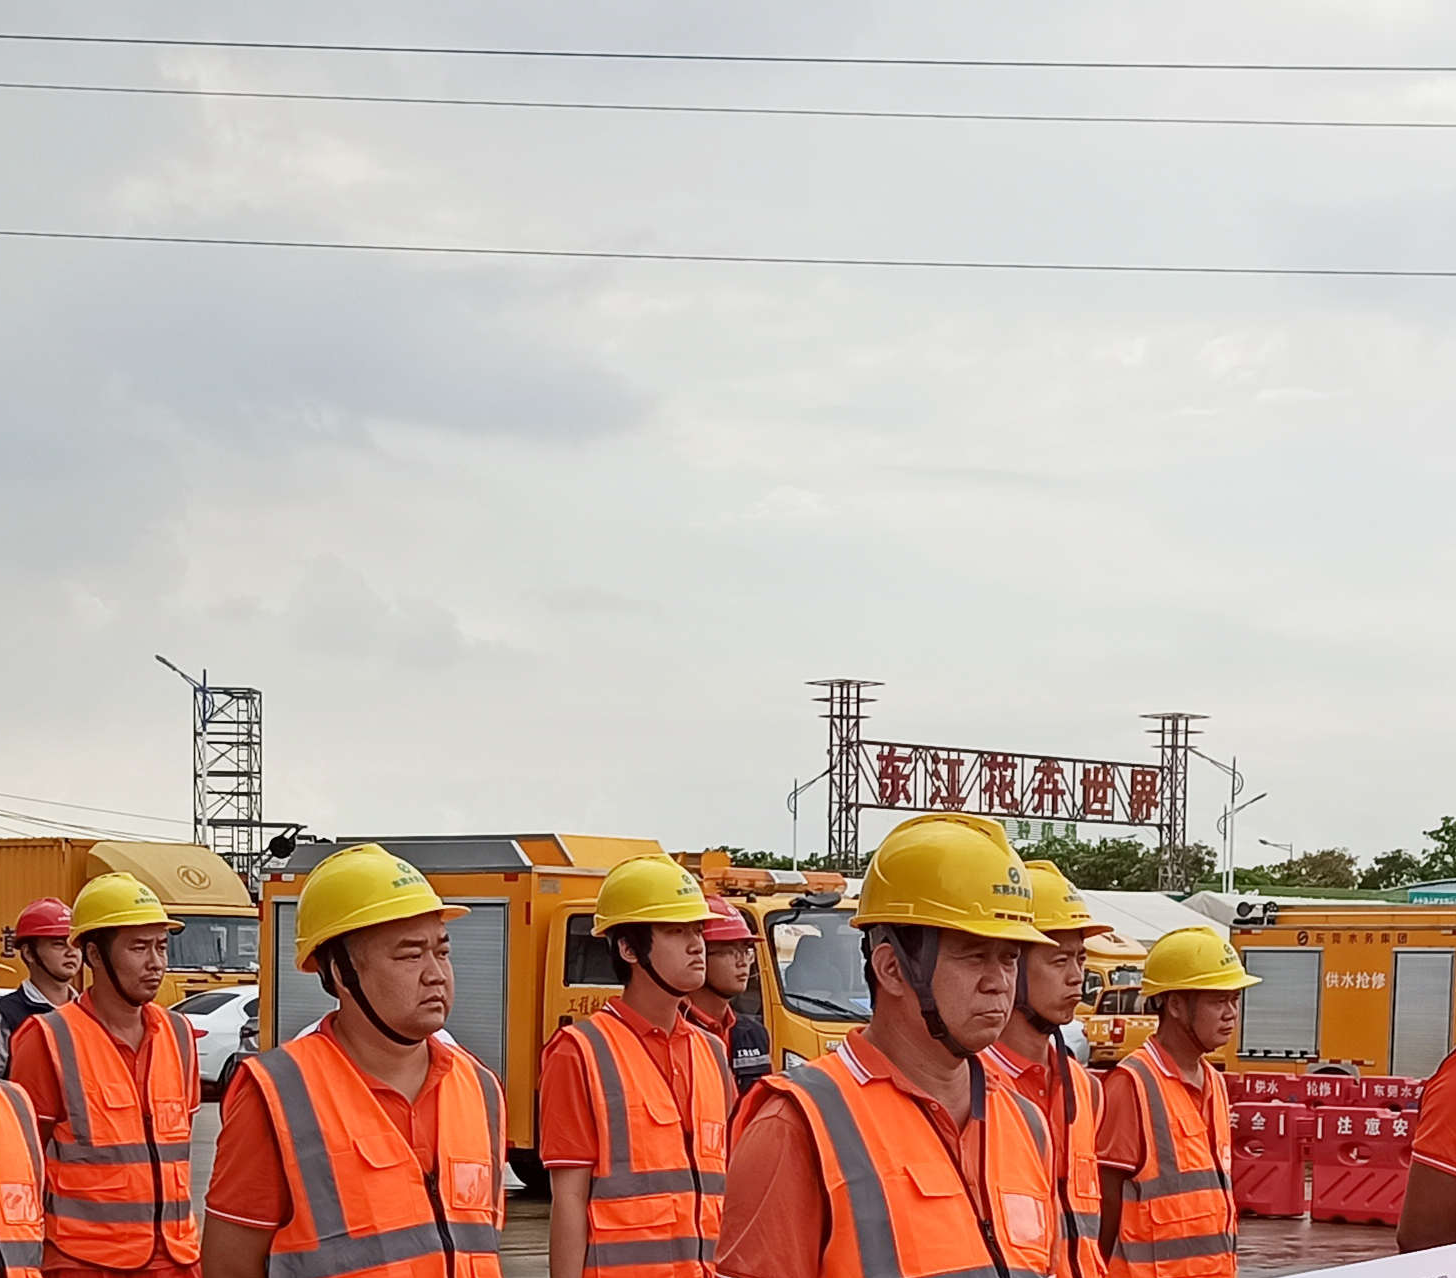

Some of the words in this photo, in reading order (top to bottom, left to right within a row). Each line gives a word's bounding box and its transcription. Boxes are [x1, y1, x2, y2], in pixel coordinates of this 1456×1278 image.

[877, 746, 1159, 823] 东江花卉世界
[1315, 932, 1408, 944] 东莞水务集团
[1325, 972, 1386, 989] 供水抢修
[1255, 1080, 1279, 1095] 供水
